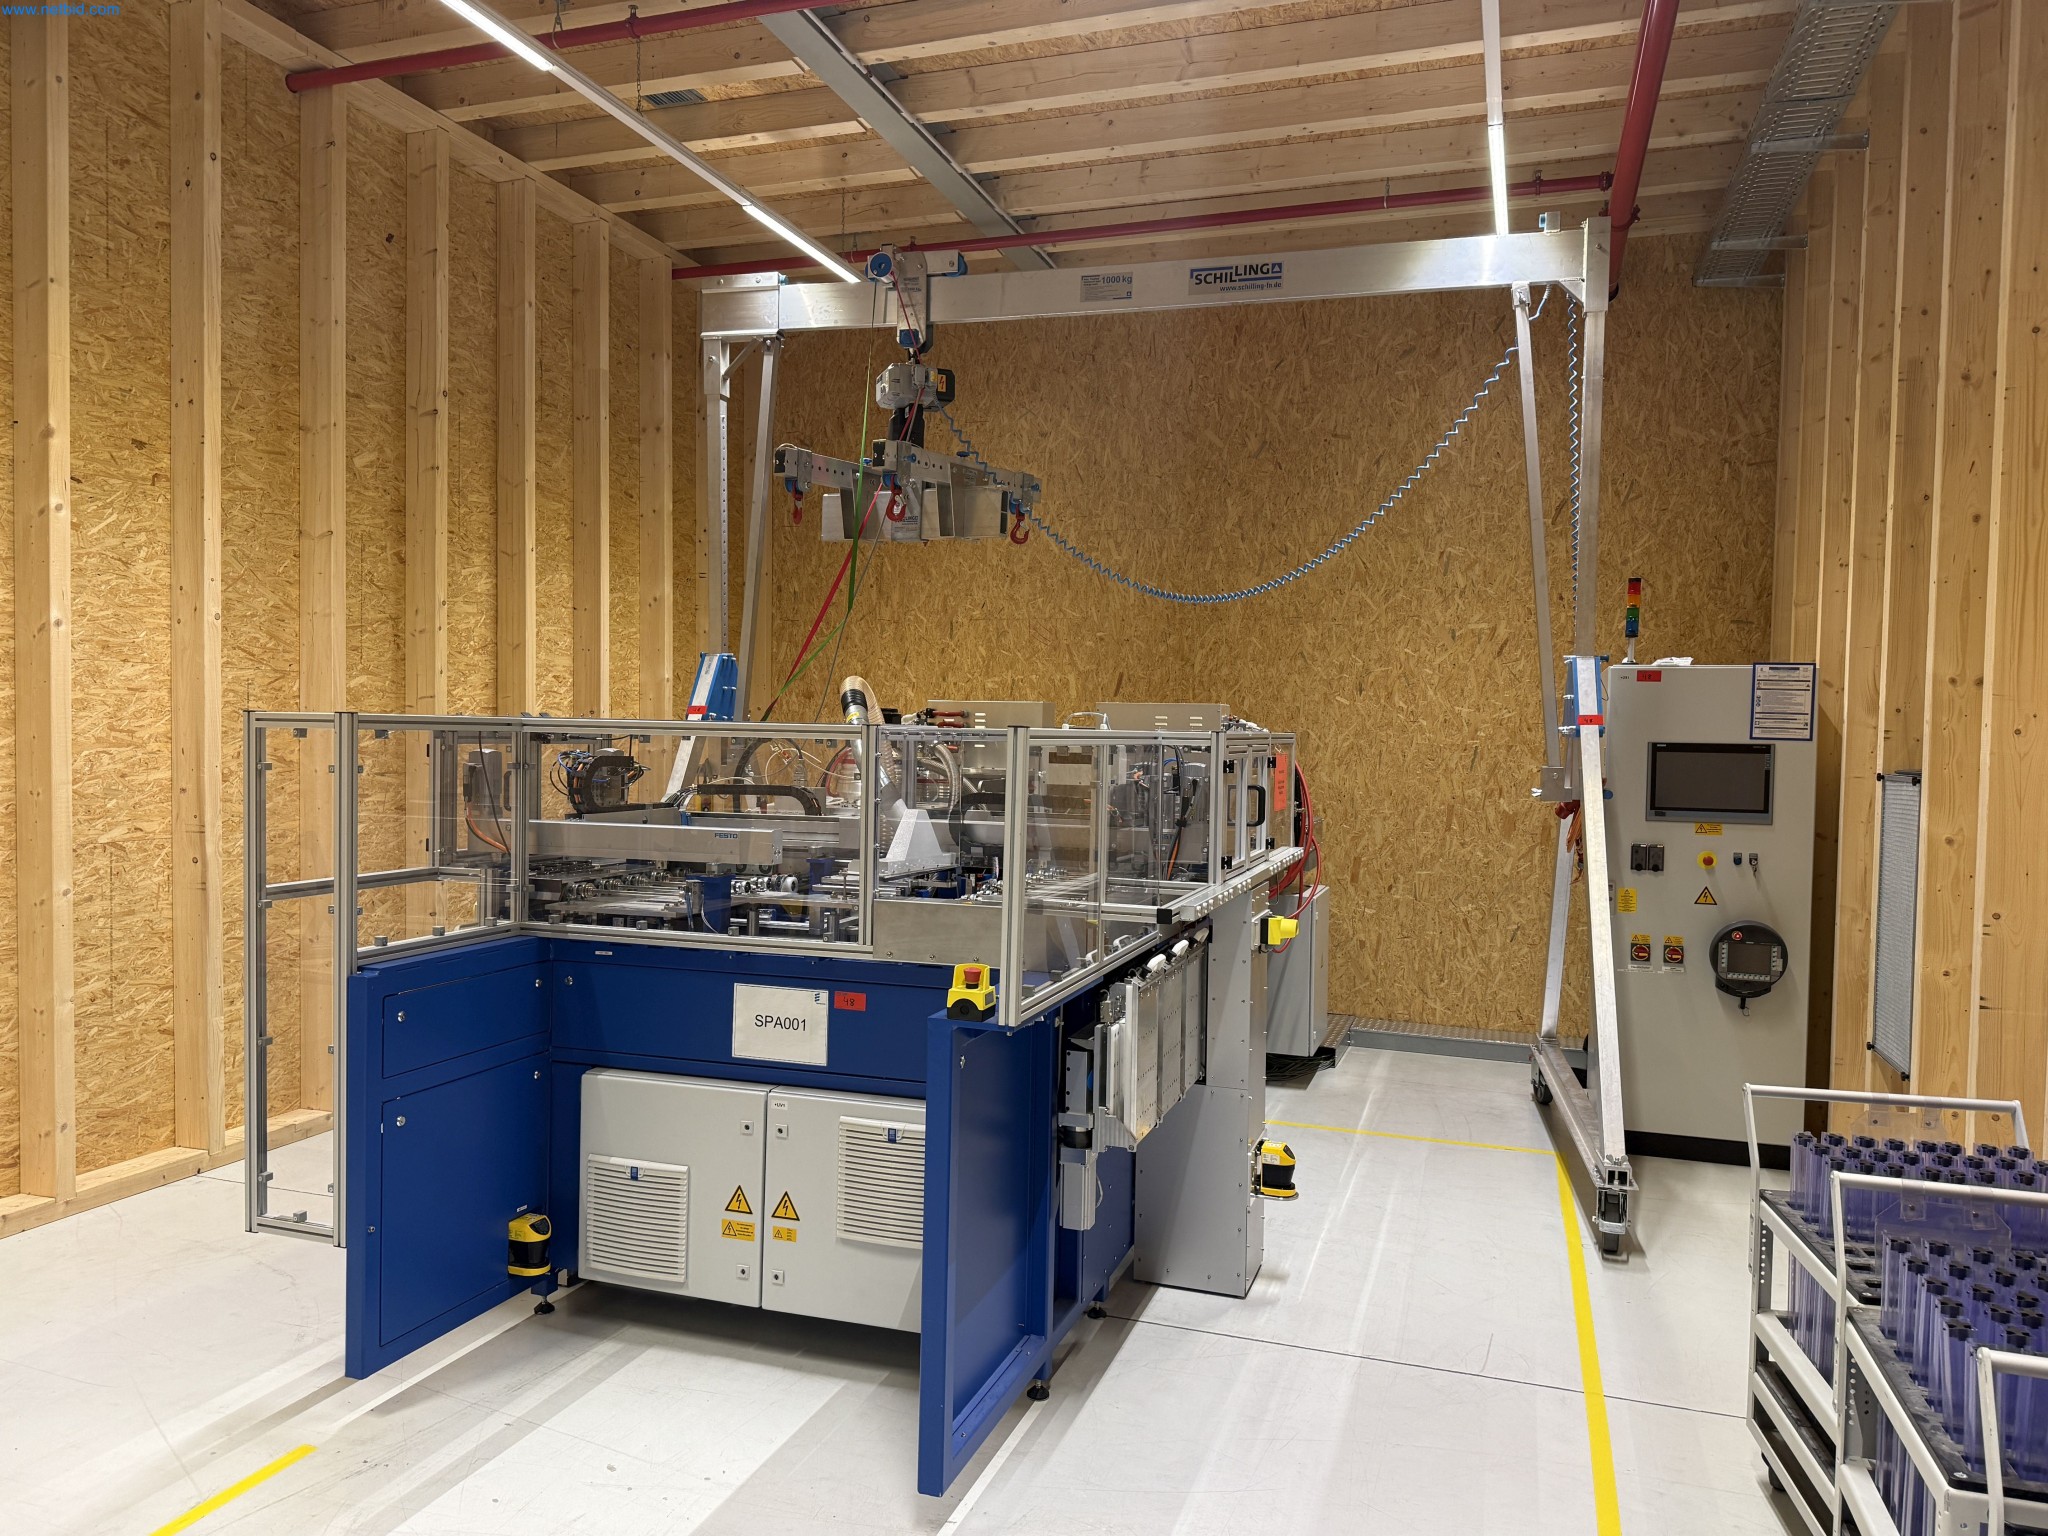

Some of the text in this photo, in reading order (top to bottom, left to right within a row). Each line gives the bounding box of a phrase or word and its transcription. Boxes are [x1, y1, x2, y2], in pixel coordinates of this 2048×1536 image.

[1102, 275, 1120, 284] 1000
[1122, 275, 1132, 284] kg
[1194, 263, 1270, 285] SCHILLING
[843, 996, 856, 1007] 48
[754, 1014, 806, 1032] SPA001
